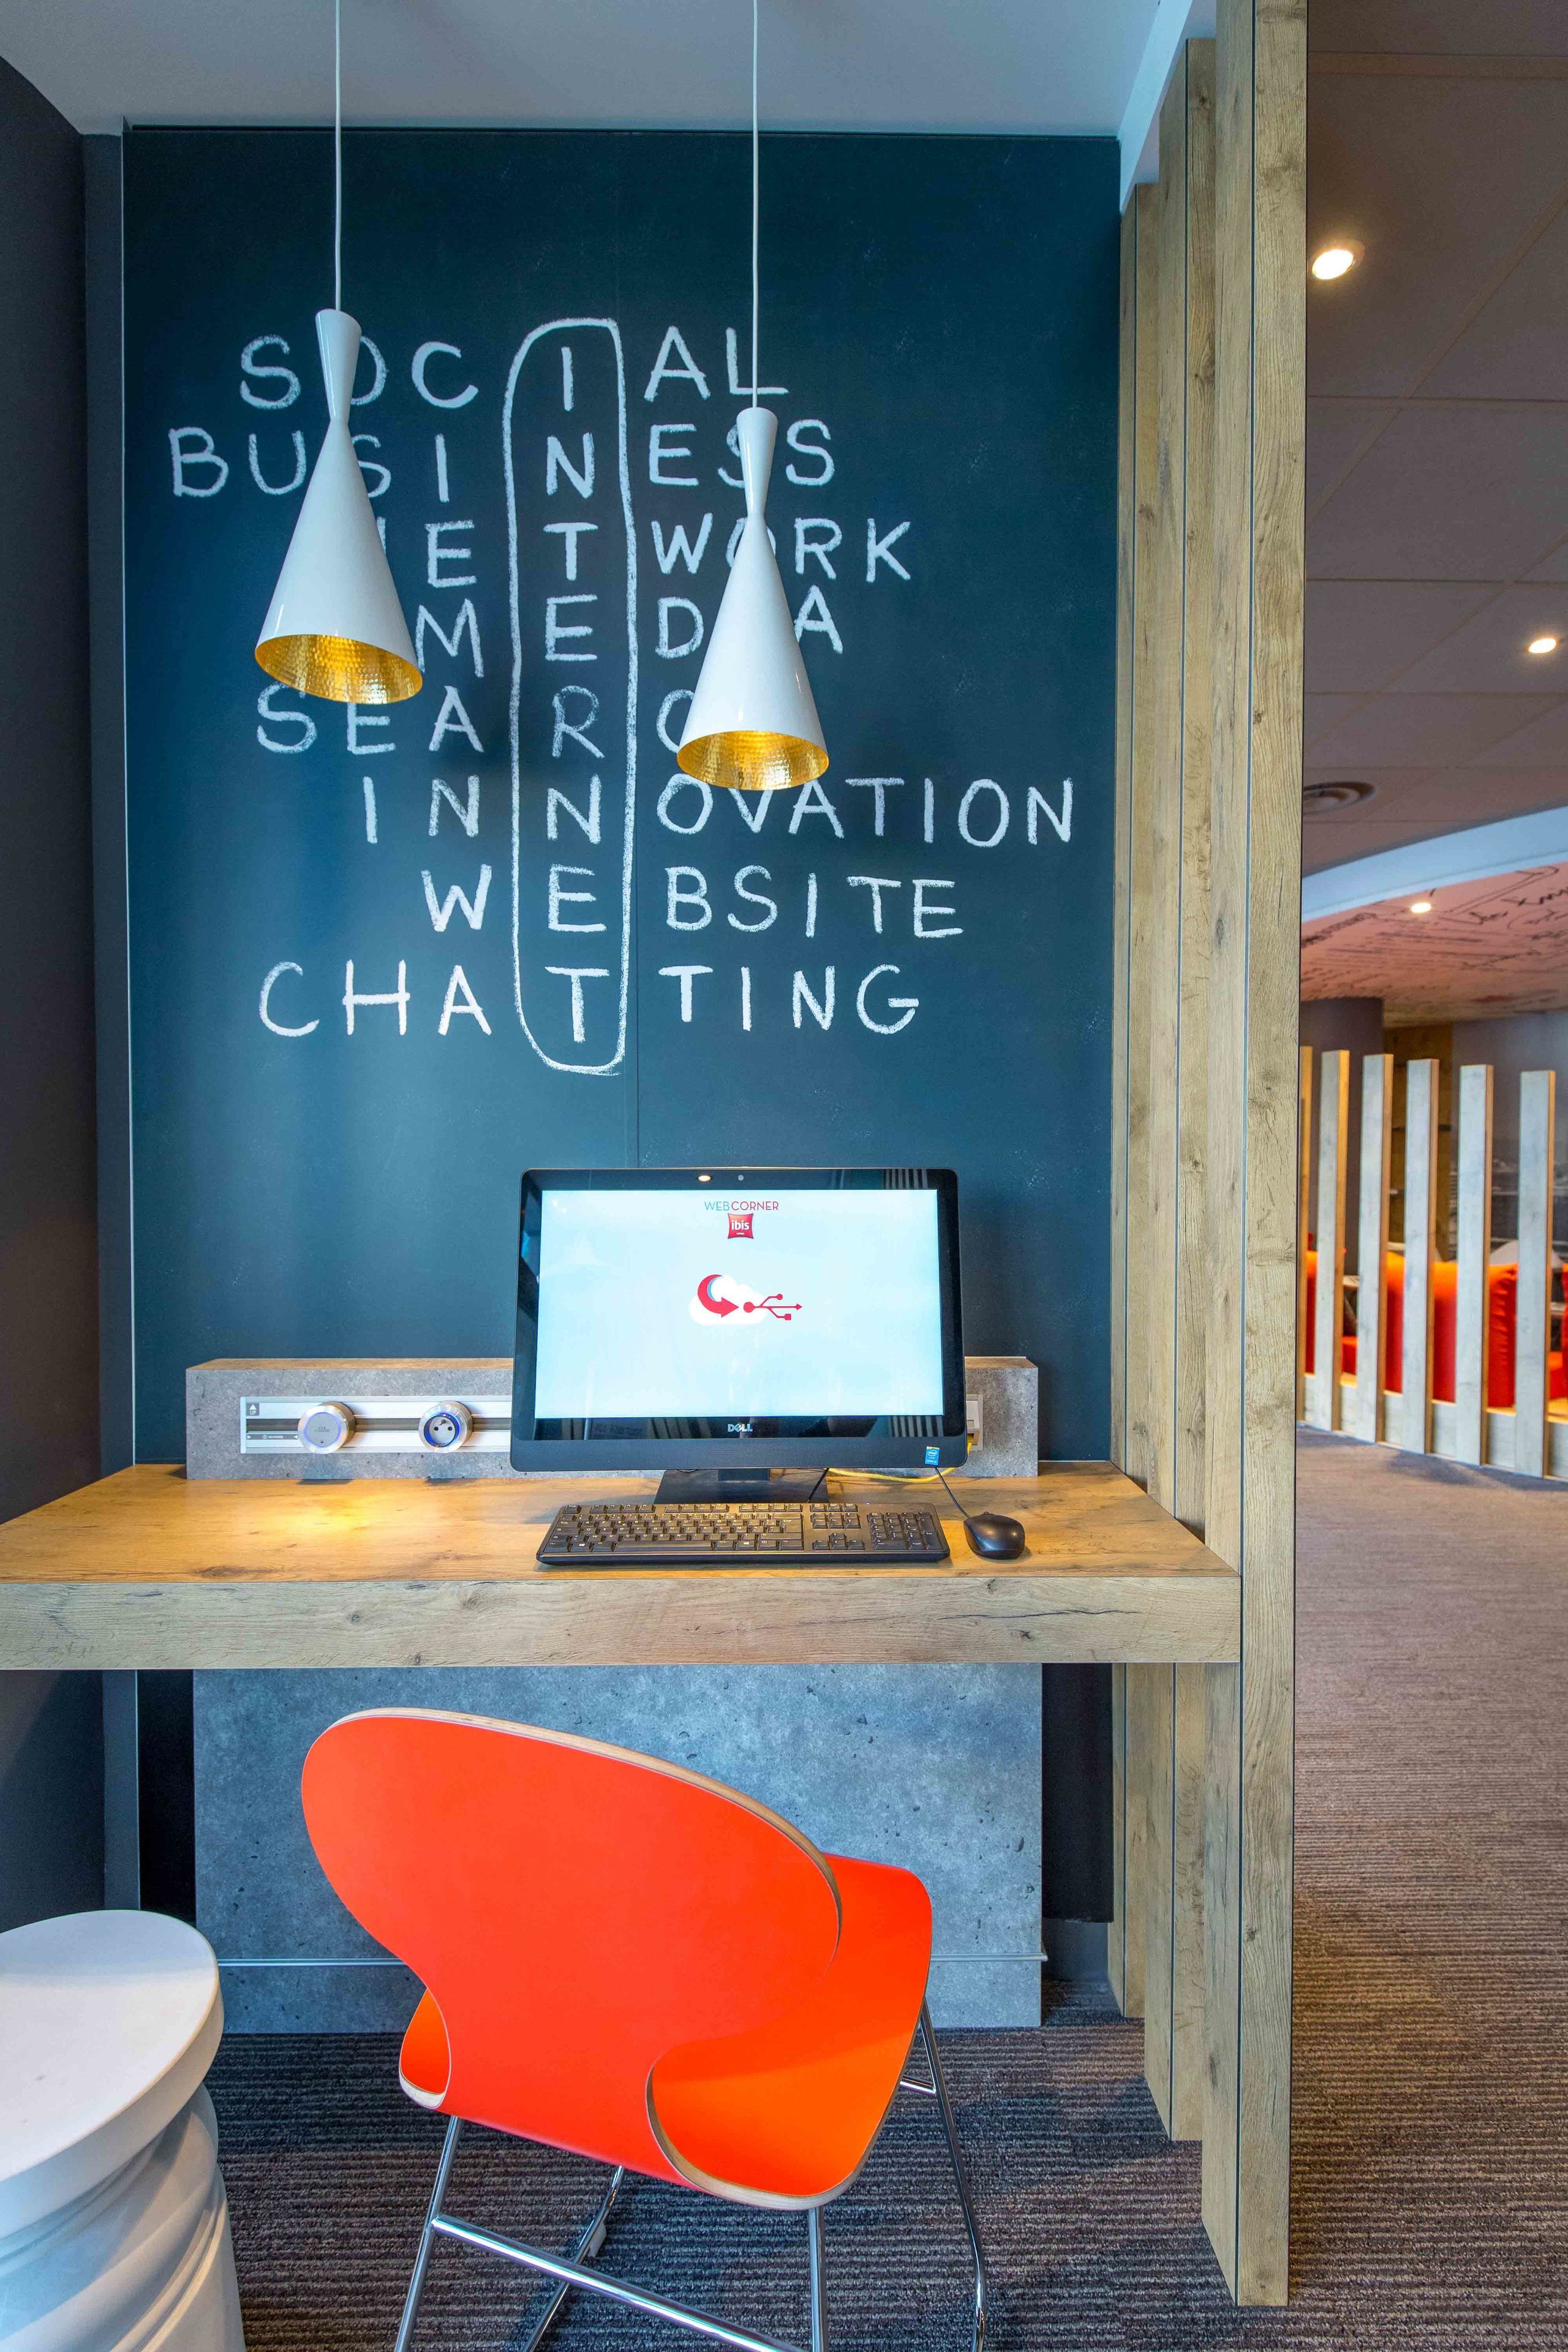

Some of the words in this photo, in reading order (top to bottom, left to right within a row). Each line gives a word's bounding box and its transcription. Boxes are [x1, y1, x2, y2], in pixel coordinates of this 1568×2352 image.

[377, 513, 911, 588] ETWRK
[415, 585, 843, 677] MEDA
[257, 681, 695, 758] SEARC
[364, 773, 1073, 847] INNOVATION
[421, 864, 963, 938] WEBSITE
[258, 959, 919, 1044] CHATTING
[731, 1219, 750, 1230] ibis
[728, 1423, 753, 1432] DELL
